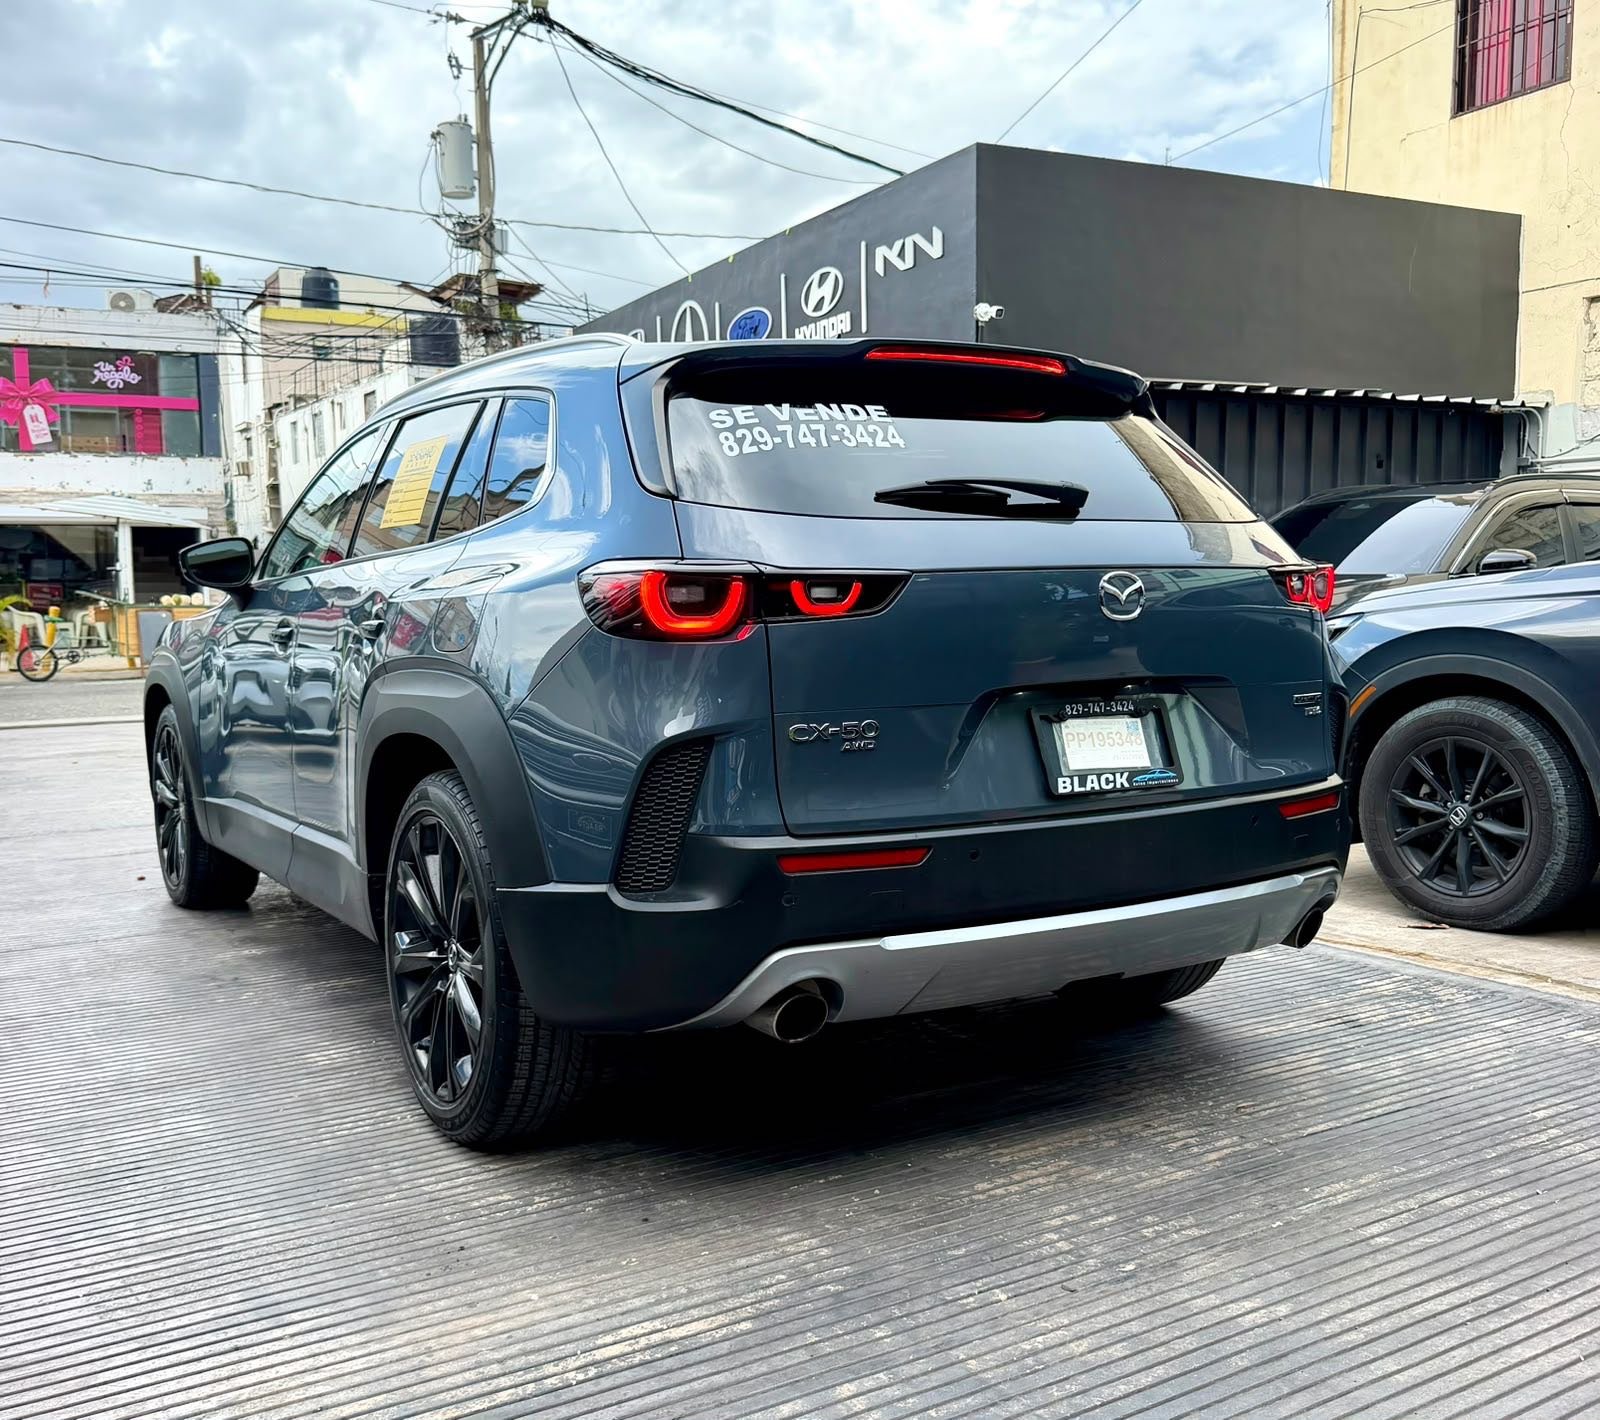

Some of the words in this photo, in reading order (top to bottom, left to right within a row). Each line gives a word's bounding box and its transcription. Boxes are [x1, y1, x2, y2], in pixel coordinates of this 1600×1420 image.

[795, 311, 851, 339] HYUNDAI
[708, 405, 760, 428] SE
[765, 403, 894, 423] VENDE
[718, 424, 906, 457] 829-747-3424
[1065, 700, 1135, 715] 829-747-3424
[789, 720, 880, 741] CX-50
[841, 740, 876, 752] AWD
[1057, 771, 1130, 794] BLACK
